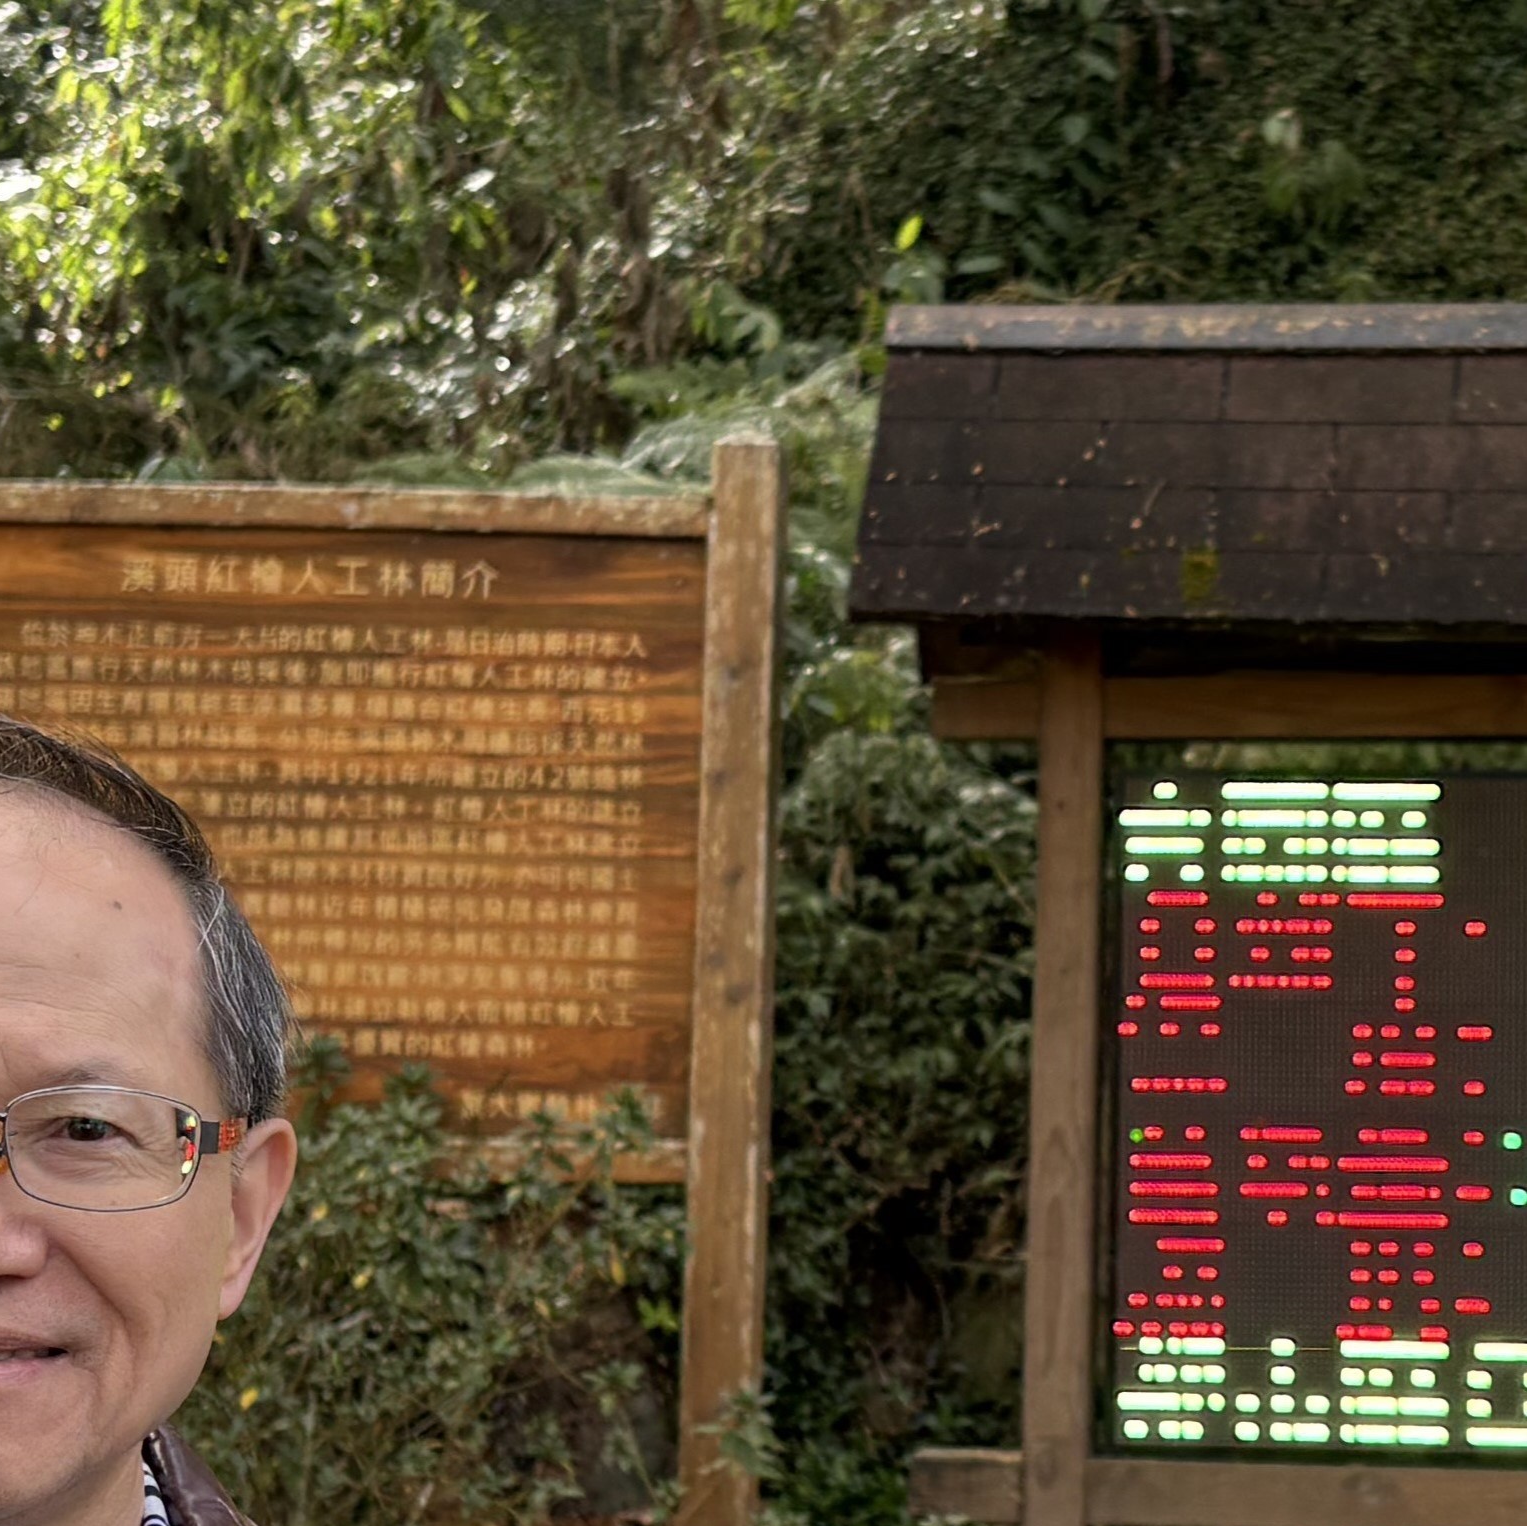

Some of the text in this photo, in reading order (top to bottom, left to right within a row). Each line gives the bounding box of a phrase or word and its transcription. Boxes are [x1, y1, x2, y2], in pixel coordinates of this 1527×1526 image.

[121, 555, 500, 598] 溪頭紅檜人工林簡介
